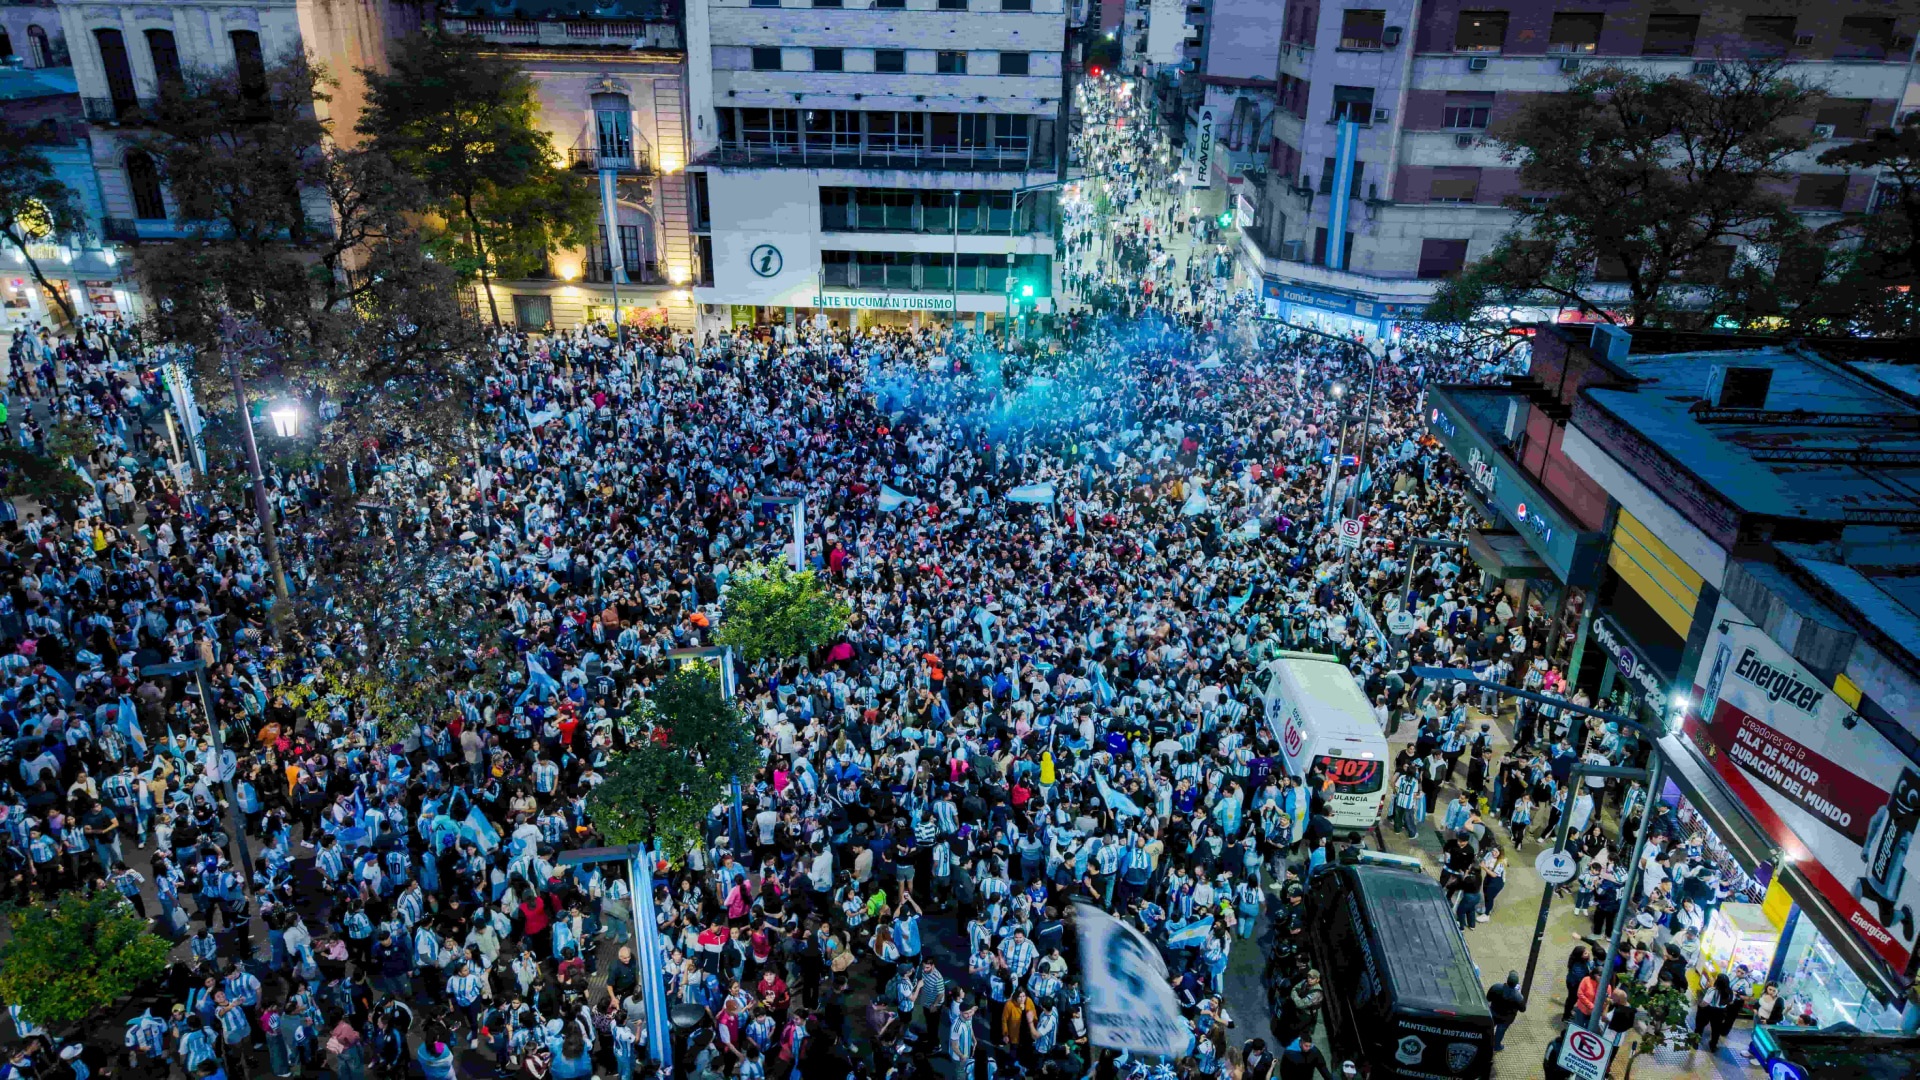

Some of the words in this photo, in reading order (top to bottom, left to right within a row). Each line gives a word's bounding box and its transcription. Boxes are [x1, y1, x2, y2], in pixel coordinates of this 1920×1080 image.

[813, 296, 841, 306] ENTE
[902, 298, 953, 309] TURISMO
[1283, 290, 1314, 304] Konica
[598, 683, 609, 695] 10
[1734, 647, 1826, 714] Energizer
[1287, 725, 1301, 751] 107
[1742, 714, 1783, 748] Creadores
[1783, 735, 1797, 755] de
[1797, 747, 1807, 761] la
[1257, 766, 1269, 777] 10
[1335, 760, 1369, 777] 107
[1763, 743, 1779, 761] DE
[1779, 753, 1820, 787] MAYOR
[1399, 782, 1412, 796] 10
[1731, 742, 1784, 786] DURACIÓN
[1782, 776, 1804, 800] DEL
[1803, 791, 1852, 828] MUNDO
[1333, 794, 1368, 802] ULANCIA
[1874, 818, 1897, 880] Energizer
[389, 862, 401, 875] 10
[1850, 911, 1892, 946] Energizer
[1398, 1020, 1442, 1035] MANTENGA
[1442, 1028, 1483, 1040] DISTANCIA
[1564, 1056, 1599, 1077] ESTACIONAR
[1567, 1052, 1598, 1070] PROHIBIDO
